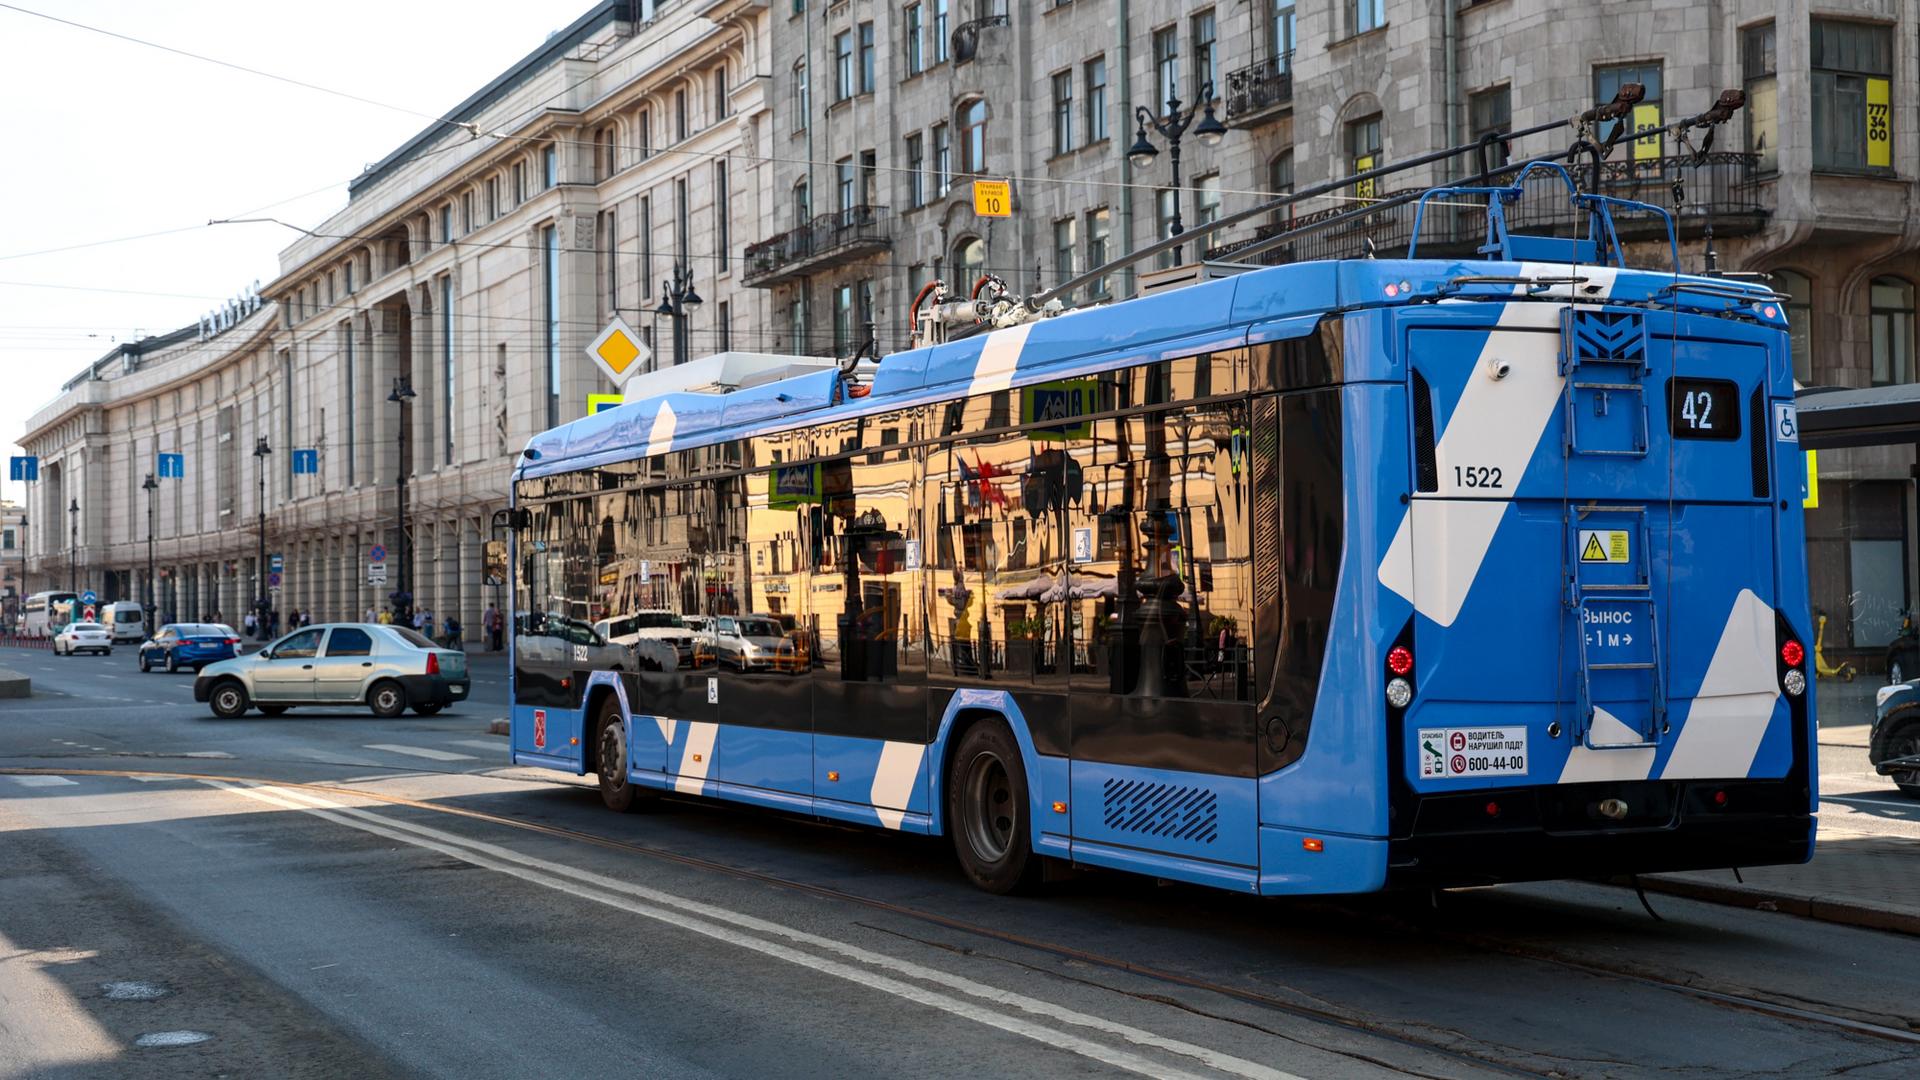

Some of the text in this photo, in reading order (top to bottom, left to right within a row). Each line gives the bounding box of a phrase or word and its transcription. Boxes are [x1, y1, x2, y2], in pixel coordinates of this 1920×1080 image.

[1868, 104, 1888, 115] 777
[1870, 116, 1886, 128] 34
[1869, 129, 1887, 141] 00
[986, 198, 1000, 213] 10
[1682, 391, 1712, 429] 42
[1455, 466, 1502, 488] 1522
[1596, 630, 1619, 647] 1 м
[574, 645, 588, 661] 1522
[1468, 731, 1504, 741] ВОДИТЕЛЬ
[1468, 741, 1523, 750] НАРУШИЛ ПДД?
[1469, 756, 1523, 771] 600-44-00
